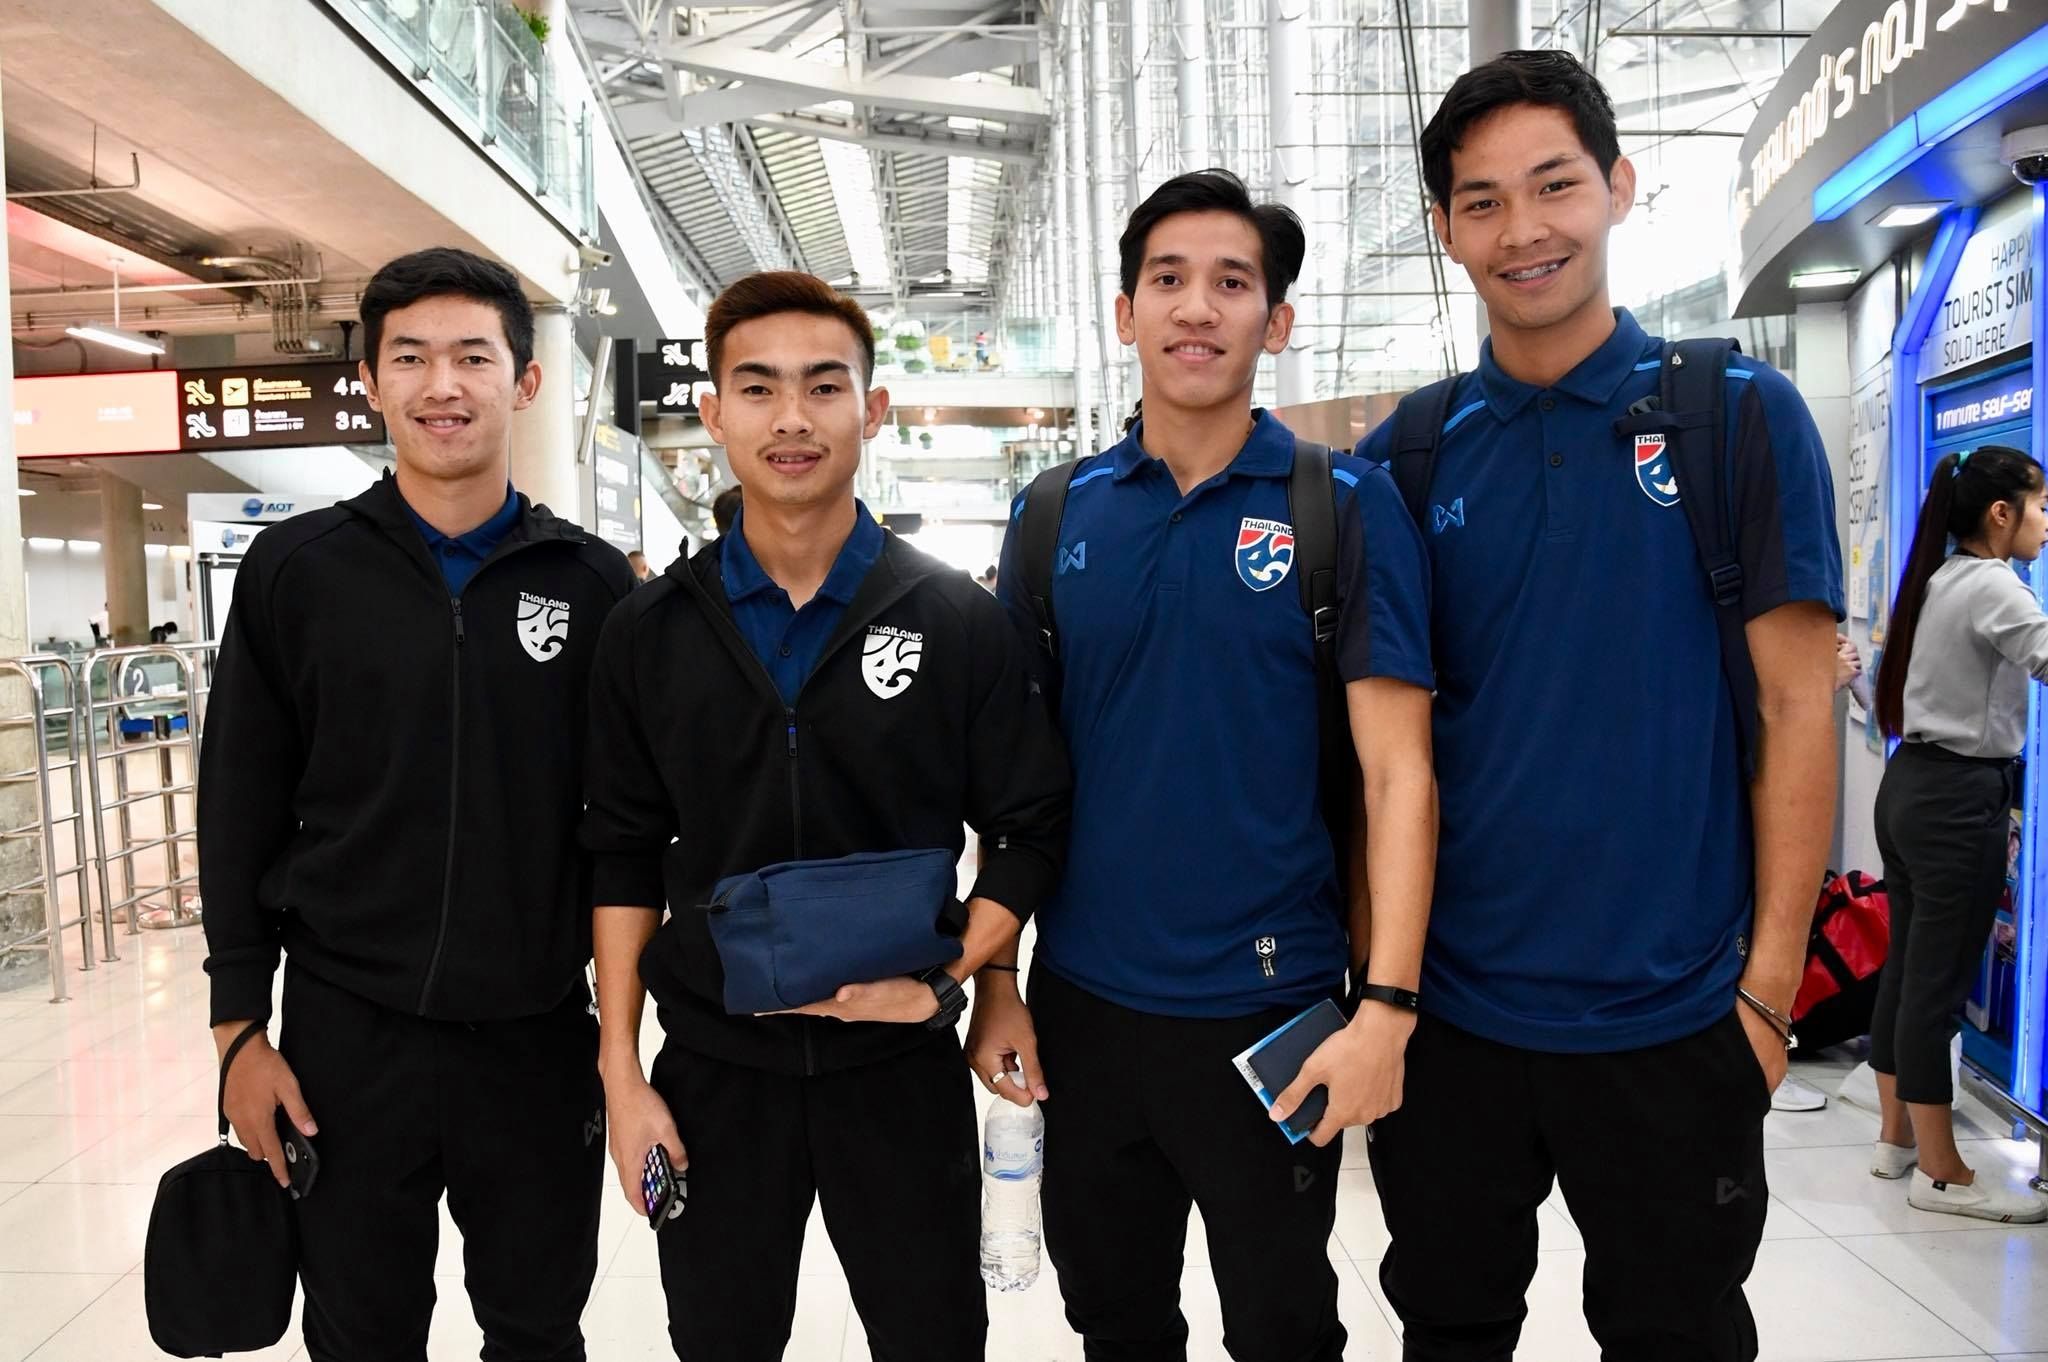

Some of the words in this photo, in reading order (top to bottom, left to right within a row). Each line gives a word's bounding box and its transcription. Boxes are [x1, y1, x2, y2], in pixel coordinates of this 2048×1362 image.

[1944, 281, 2002, 331] TOURIST
[2006, 268, 2033, 310] SIM
[1944, 335, 1972, 367] SOLD
[1976, 323, 2006, 357] HERE
[333, 376, 349, 396] 4
[335, 410, 350, 431] 3
[265, 502, 295, 513] AOT
[1243, 519, 1294, 536] THAILAND
[519, 591, 570, 611] THAILAND
[868, 624, 923, 642] THAILAND
[132, 667, 152, 700] 2
